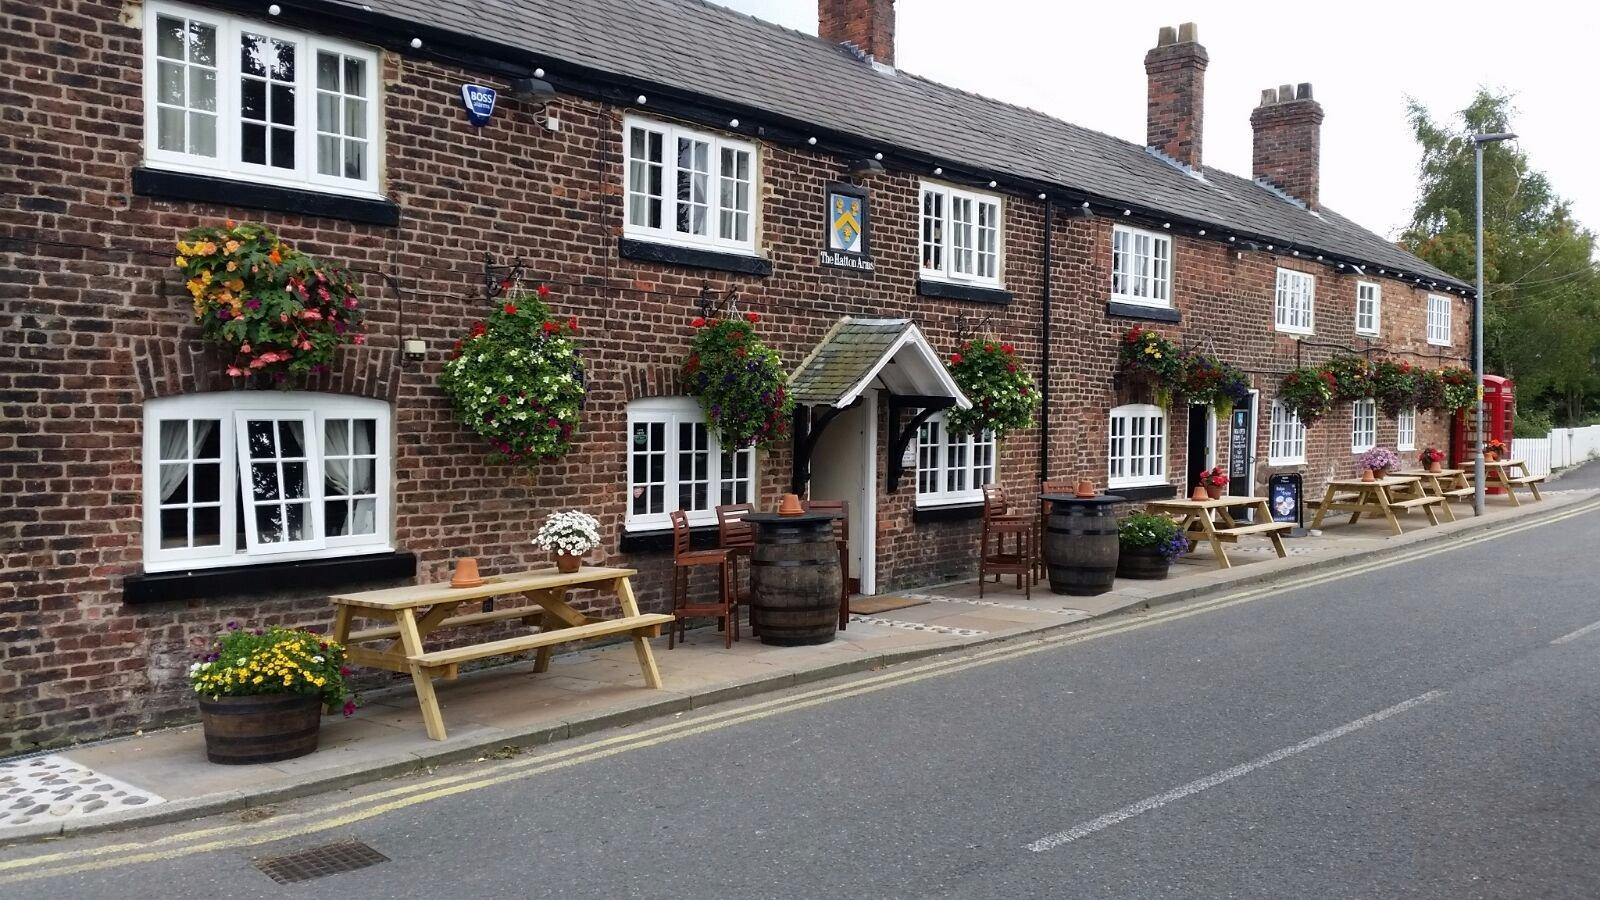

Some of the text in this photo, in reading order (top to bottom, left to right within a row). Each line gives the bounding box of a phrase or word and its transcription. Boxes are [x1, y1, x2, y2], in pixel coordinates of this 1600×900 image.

[471, 91, 492, 103] BOSS
[821, 251, 874, 270] The Hatton Arms
